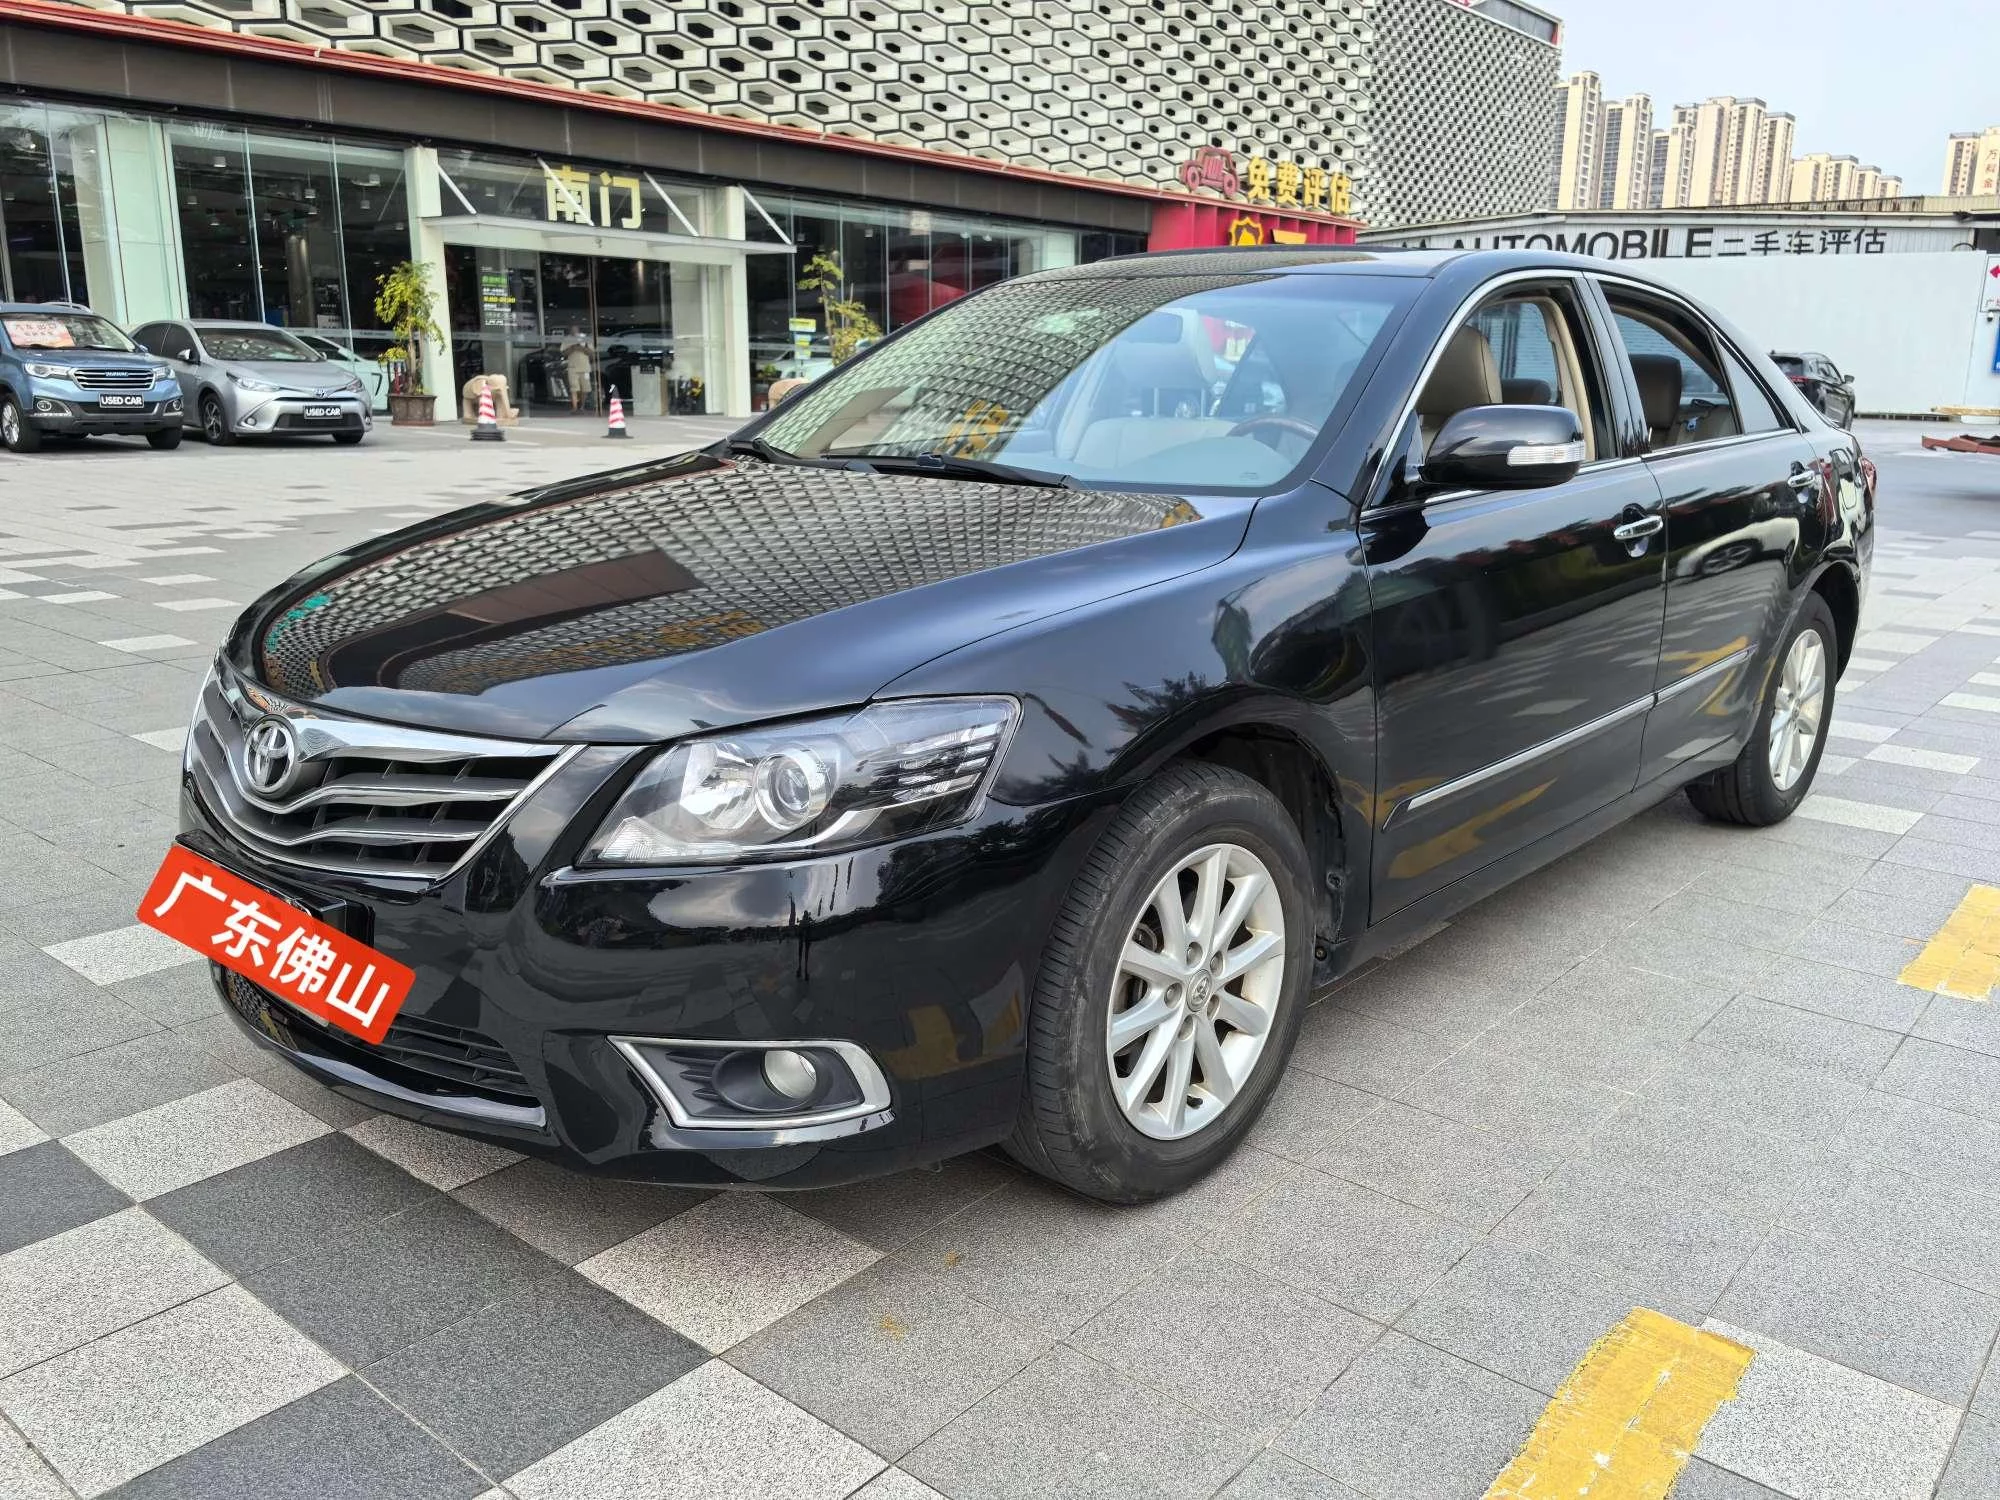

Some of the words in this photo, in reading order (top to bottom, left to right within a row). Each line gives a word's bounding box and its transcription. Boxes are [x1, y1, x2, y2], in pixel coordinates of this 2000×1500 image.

[544, 165, 641, 229] 南门
[1248, 156, 1352, 214] 免费评估
[1717, 228, 1887, 256] 二手车评估
[101, 396, 123, 405] USED
[125, 396, 142, 405] CAR
[305, 408, 324, 416] USED
[325, 408, 341, 416] CAR
